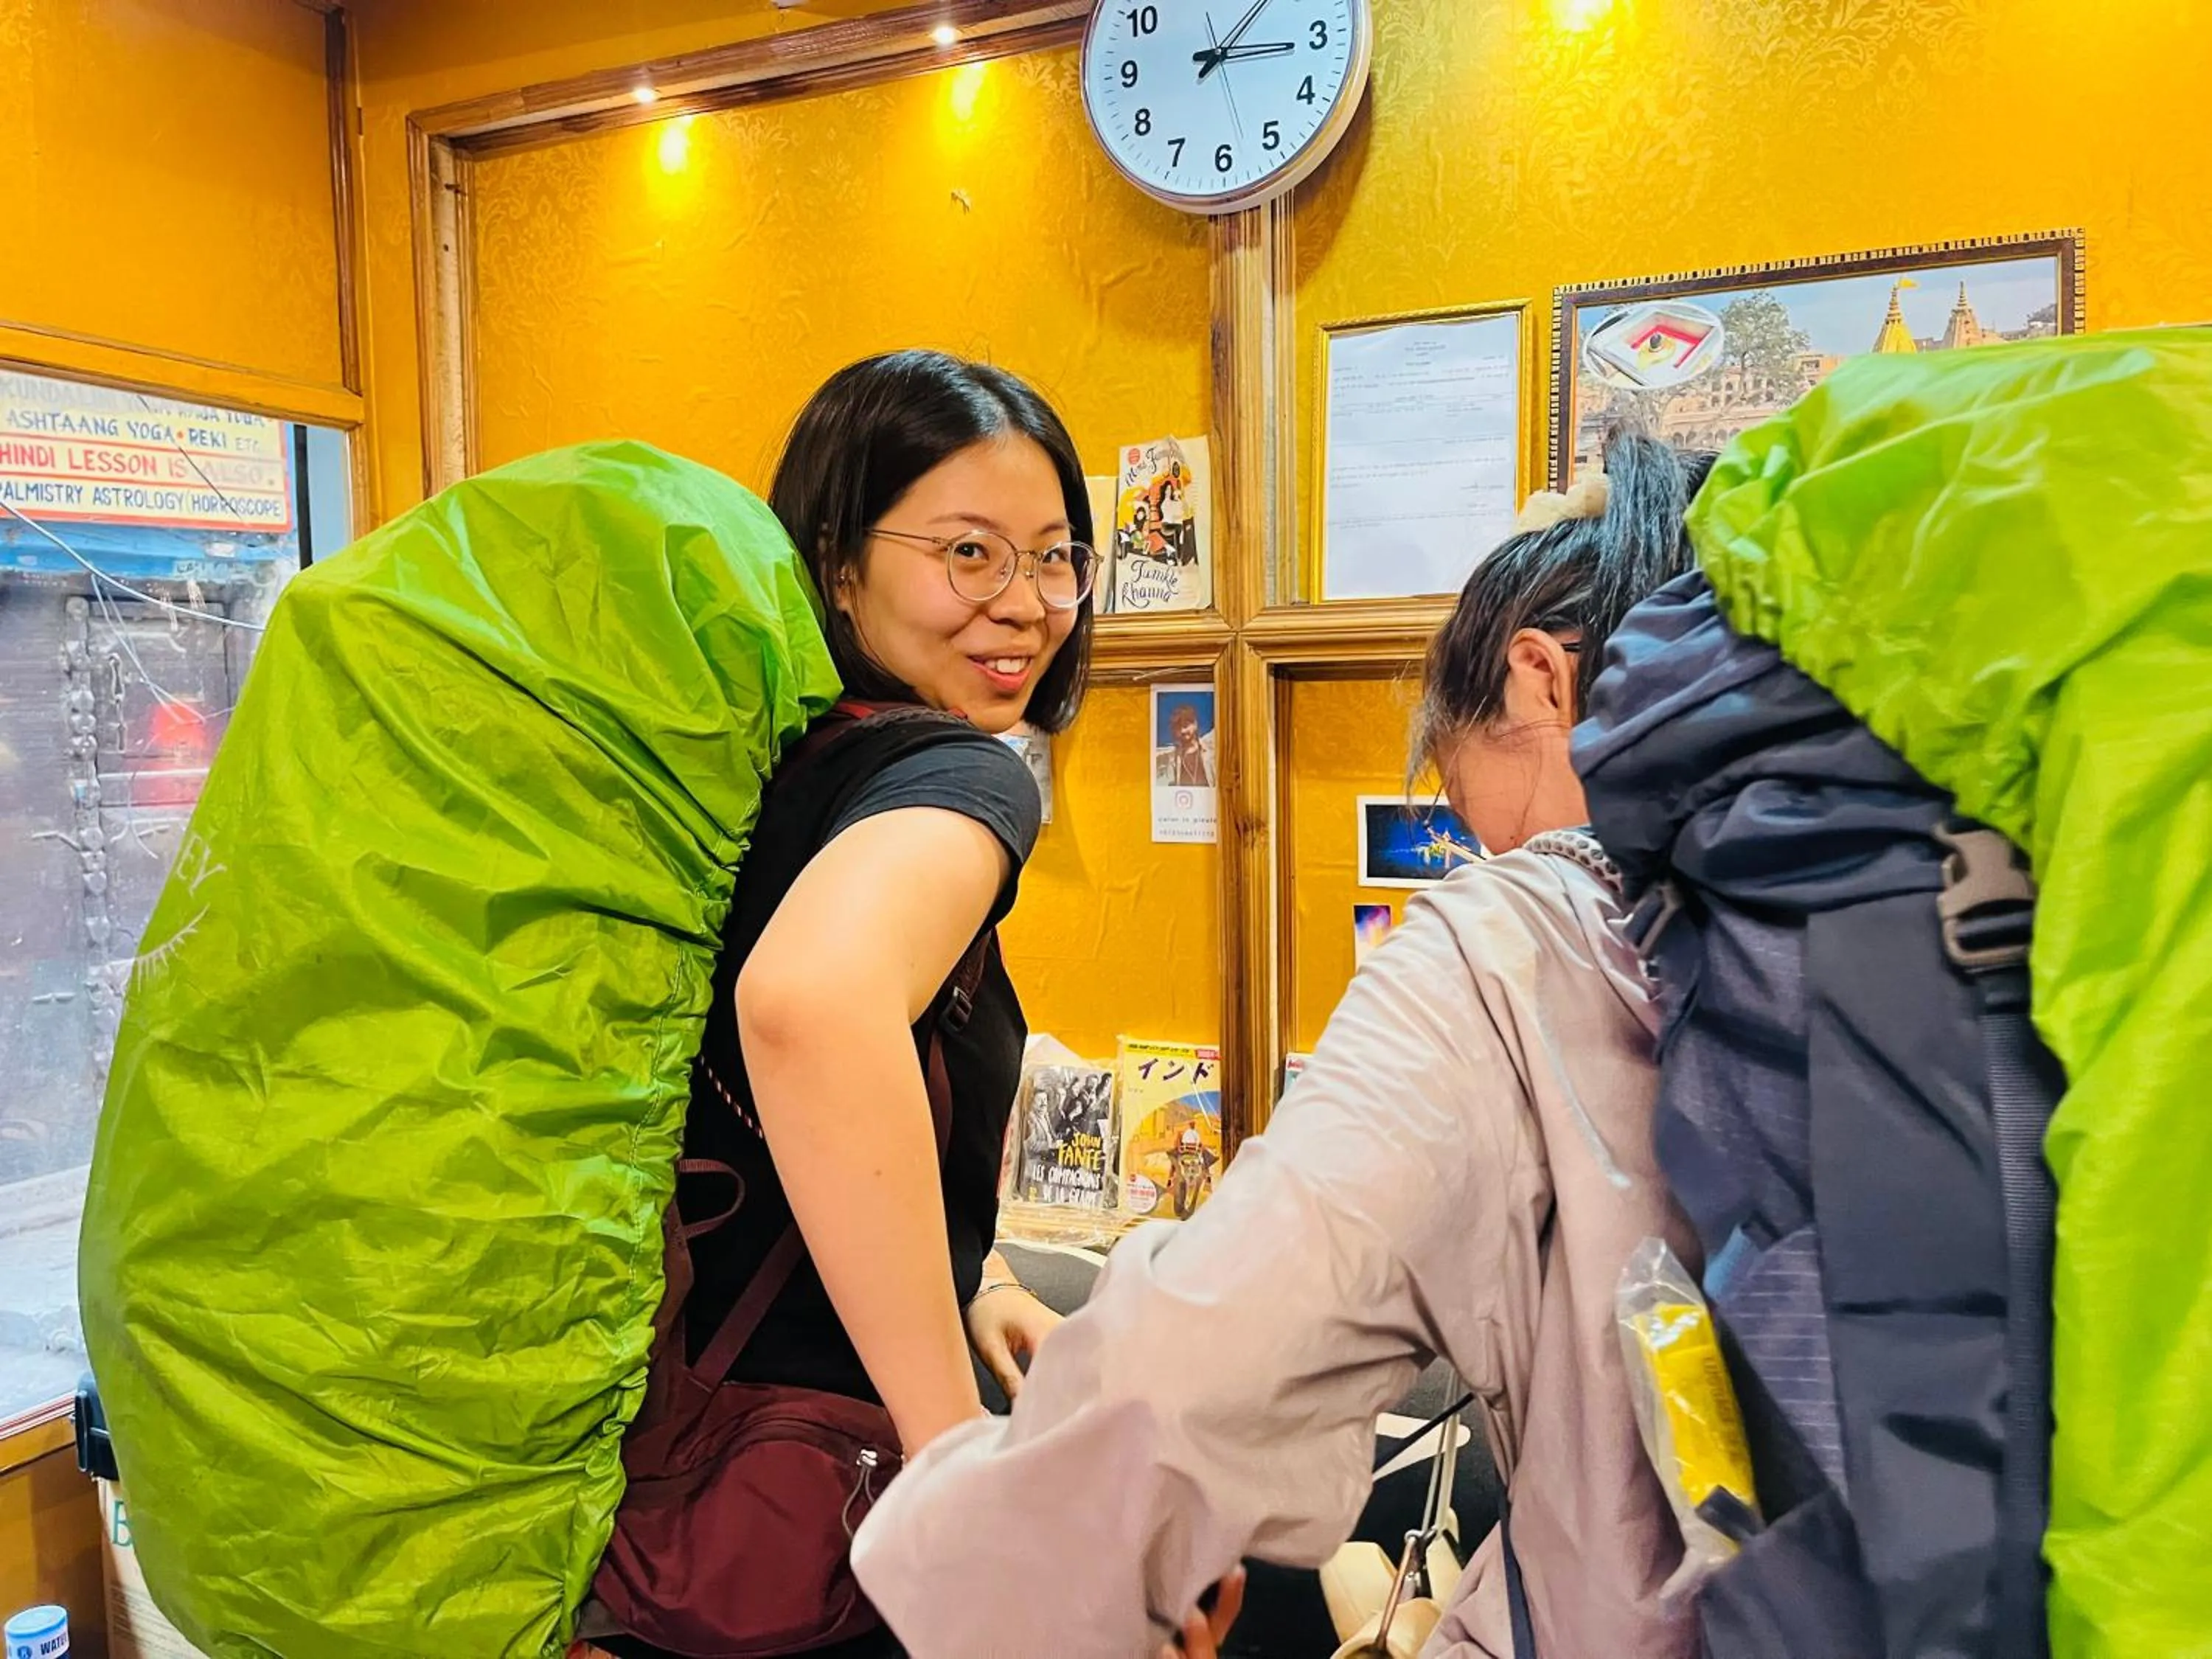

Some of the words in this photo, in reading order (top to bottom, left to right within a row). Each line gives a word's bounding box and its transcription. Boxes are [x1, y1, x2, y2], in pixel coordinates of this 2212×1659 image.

[1126, 5, 1158, 37] 10
[1309, 21, 1328, 49] 3
[1120, 60, 1138, 88] 9
[1295, 75, 1315, 105] 4
[1134, 108, 1151, 136] 8
[1262, 120, 1280, 150] 5
[1168, 138, 1186, 167] 7
[1214, 144, 1232, 172] 6
[6, 408, 119, 437] ASHTAANG
[127, 419, 175, 443] YOGA
[0, 442, 56, 468] HINDI
[68, 448, 157, 476] LESSON
[168, 457, 188, 479] IS
[1138, 1057, 1214, 1085] インド
[1071, 1132, 1101, 1149] JOHN
[1057, 1141, 1102, 1171] FANTE
